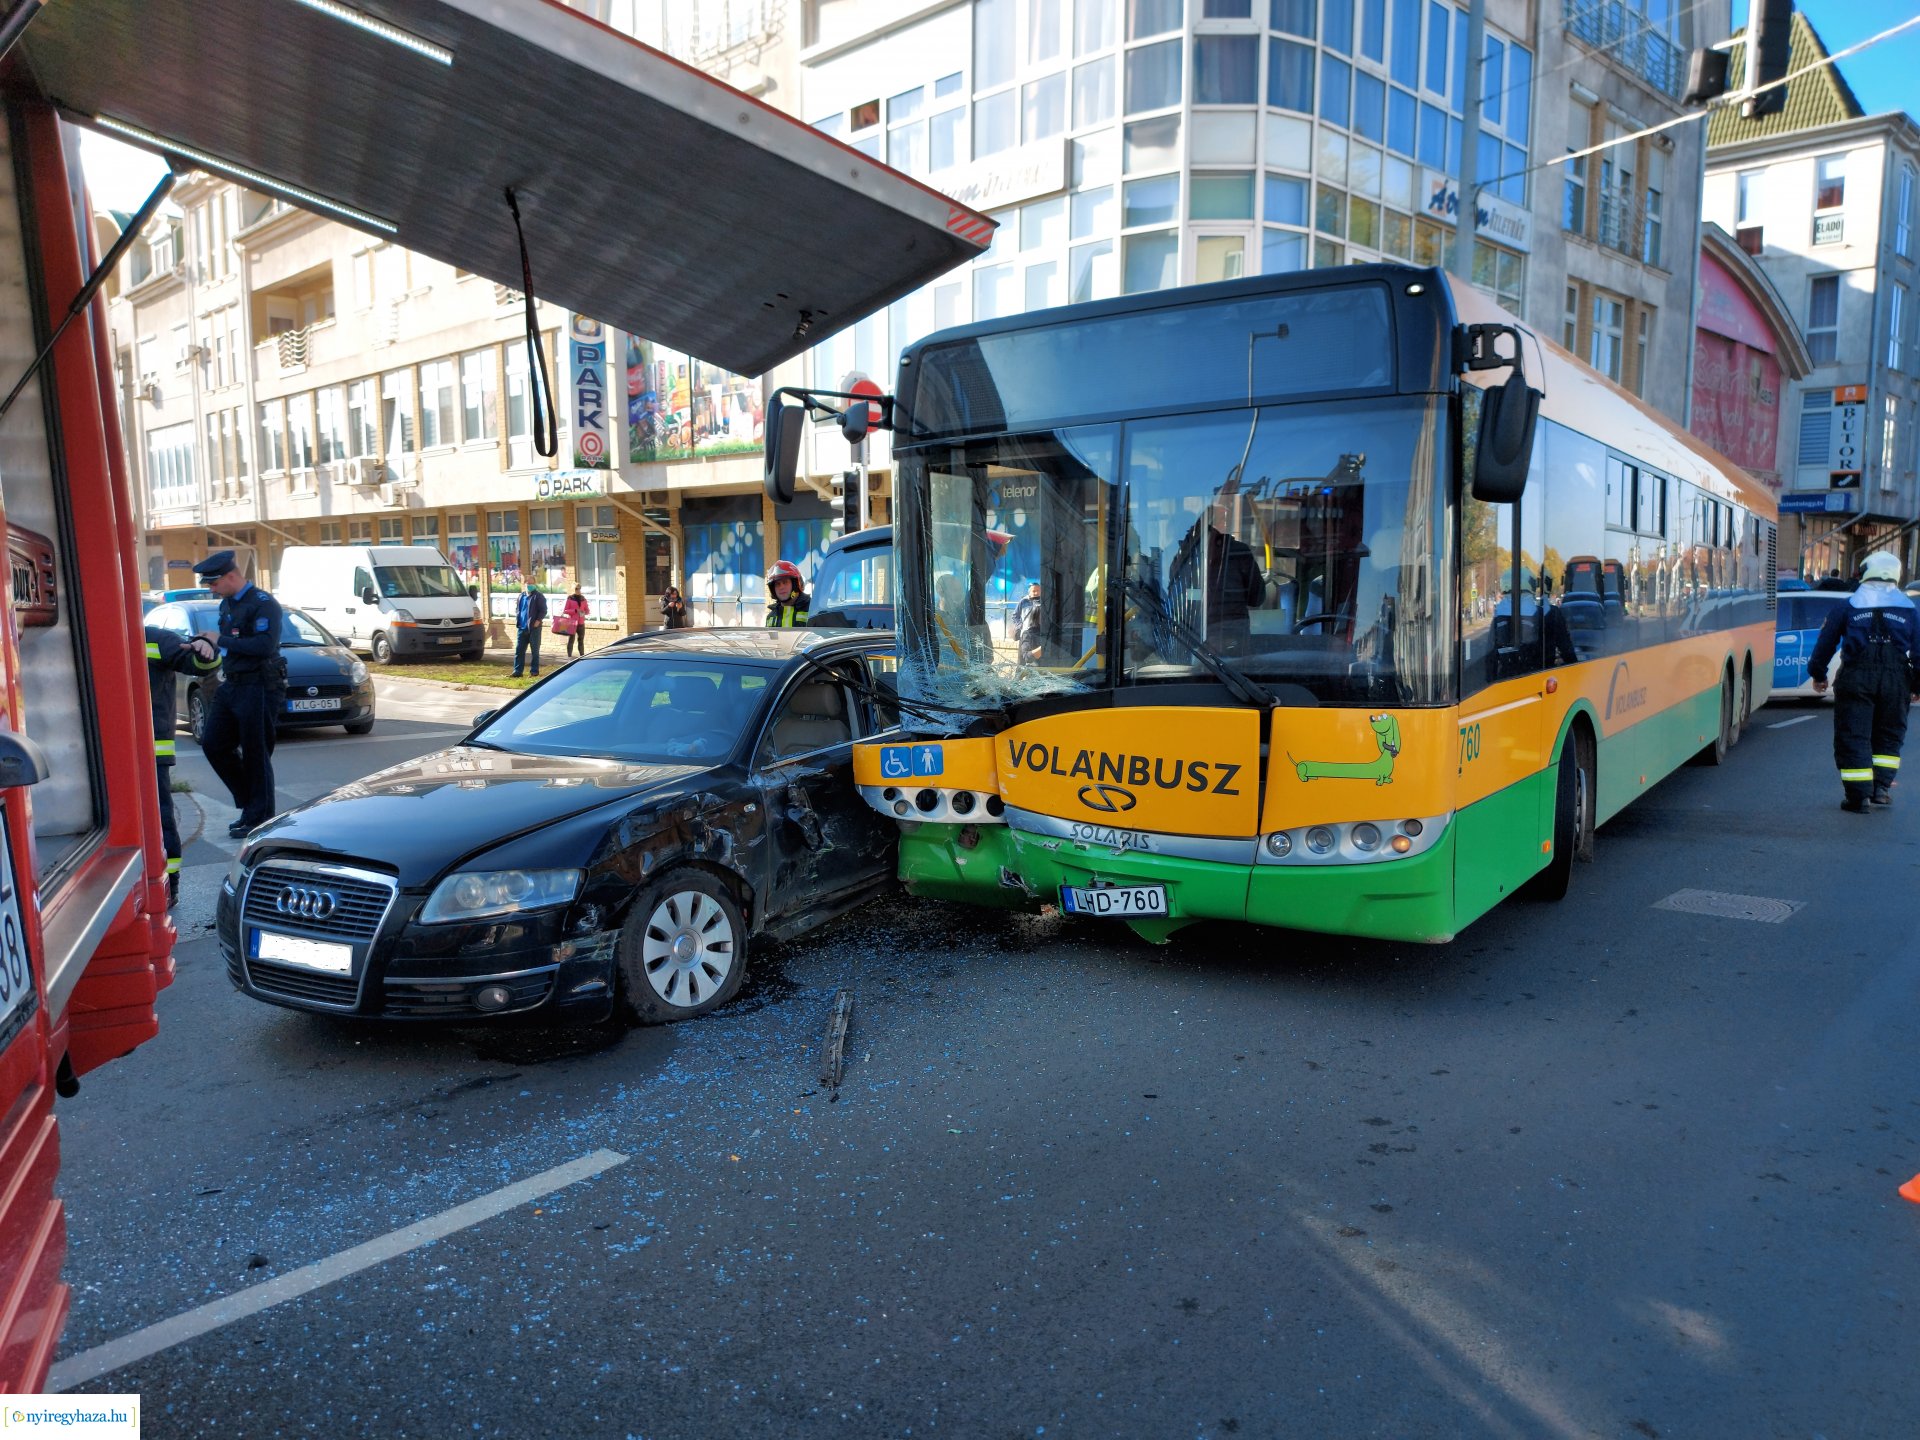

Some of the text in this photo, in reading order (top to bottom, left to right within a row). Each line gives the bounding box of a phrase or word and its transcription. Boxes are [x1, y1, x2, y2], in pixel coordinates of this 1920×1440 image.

[576, 346, 603, 429] PARK
[553, 476, 592, 496] PARK
[1002, 484, 1037, 498] telenor
[294, 699, 338, 710] KLG-051
[1459, 723, 1480, 765] 760
[1009, 739, 1242, 796] VOLÁNBUSZ
[1069, 823, 1150, 850] SOLARIS
[1075, 889, 1160, 913] LHD-760
